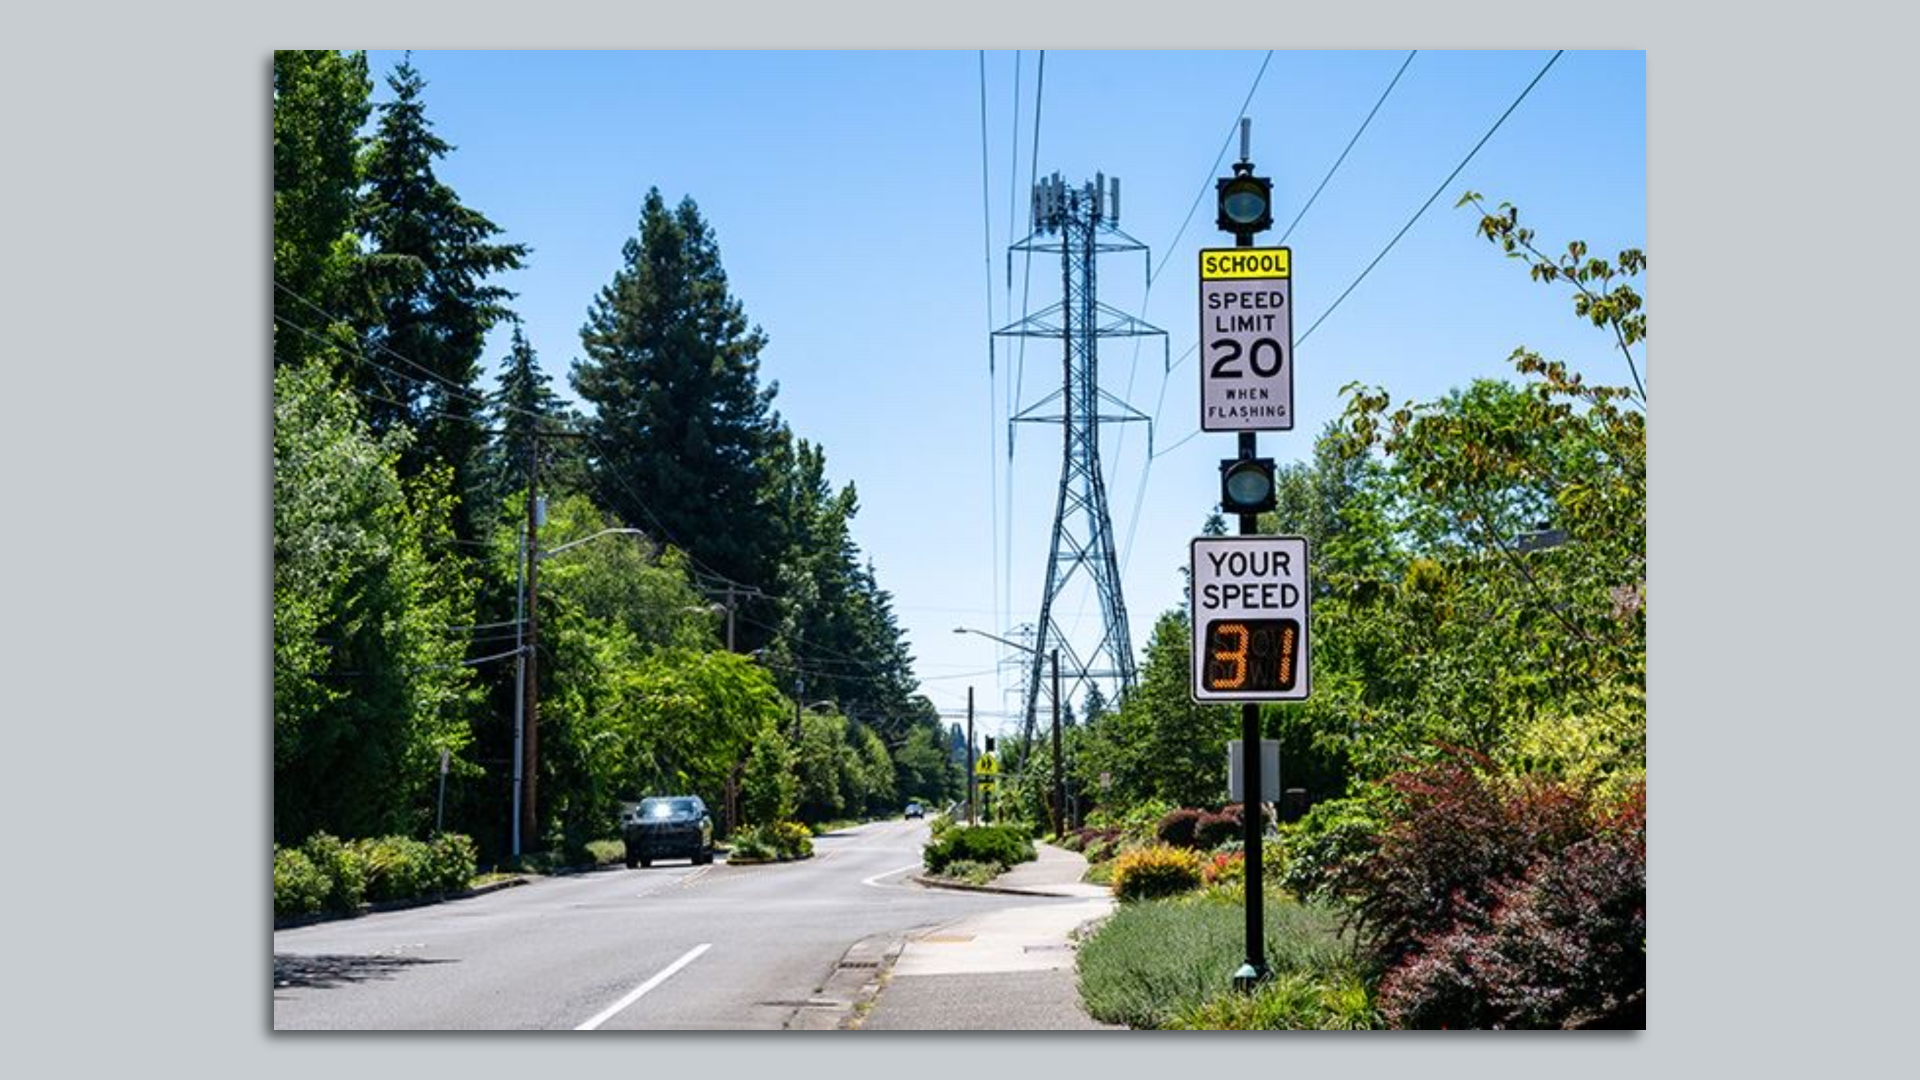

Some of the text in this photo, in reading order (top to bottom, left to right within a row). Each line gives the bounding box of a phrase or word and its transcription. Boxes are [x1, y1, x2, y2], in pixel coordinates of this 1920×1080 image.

[1206, 256, 1285, 274] SCHOOL
[1208, 291, 1284, 309] SPEED
[1216, 315, 1275, 332] LIMIT
[1210, 338, 1283, 379] 20
[1226, 389, 1269, 400] WHEN
[1208, 405, 1286, 418] FLASHING
[1207, 551, 1291, 577] YOUR
[1202, 583, 1300, 609] SPEED
[1212, 624, 1294, 688] 31
